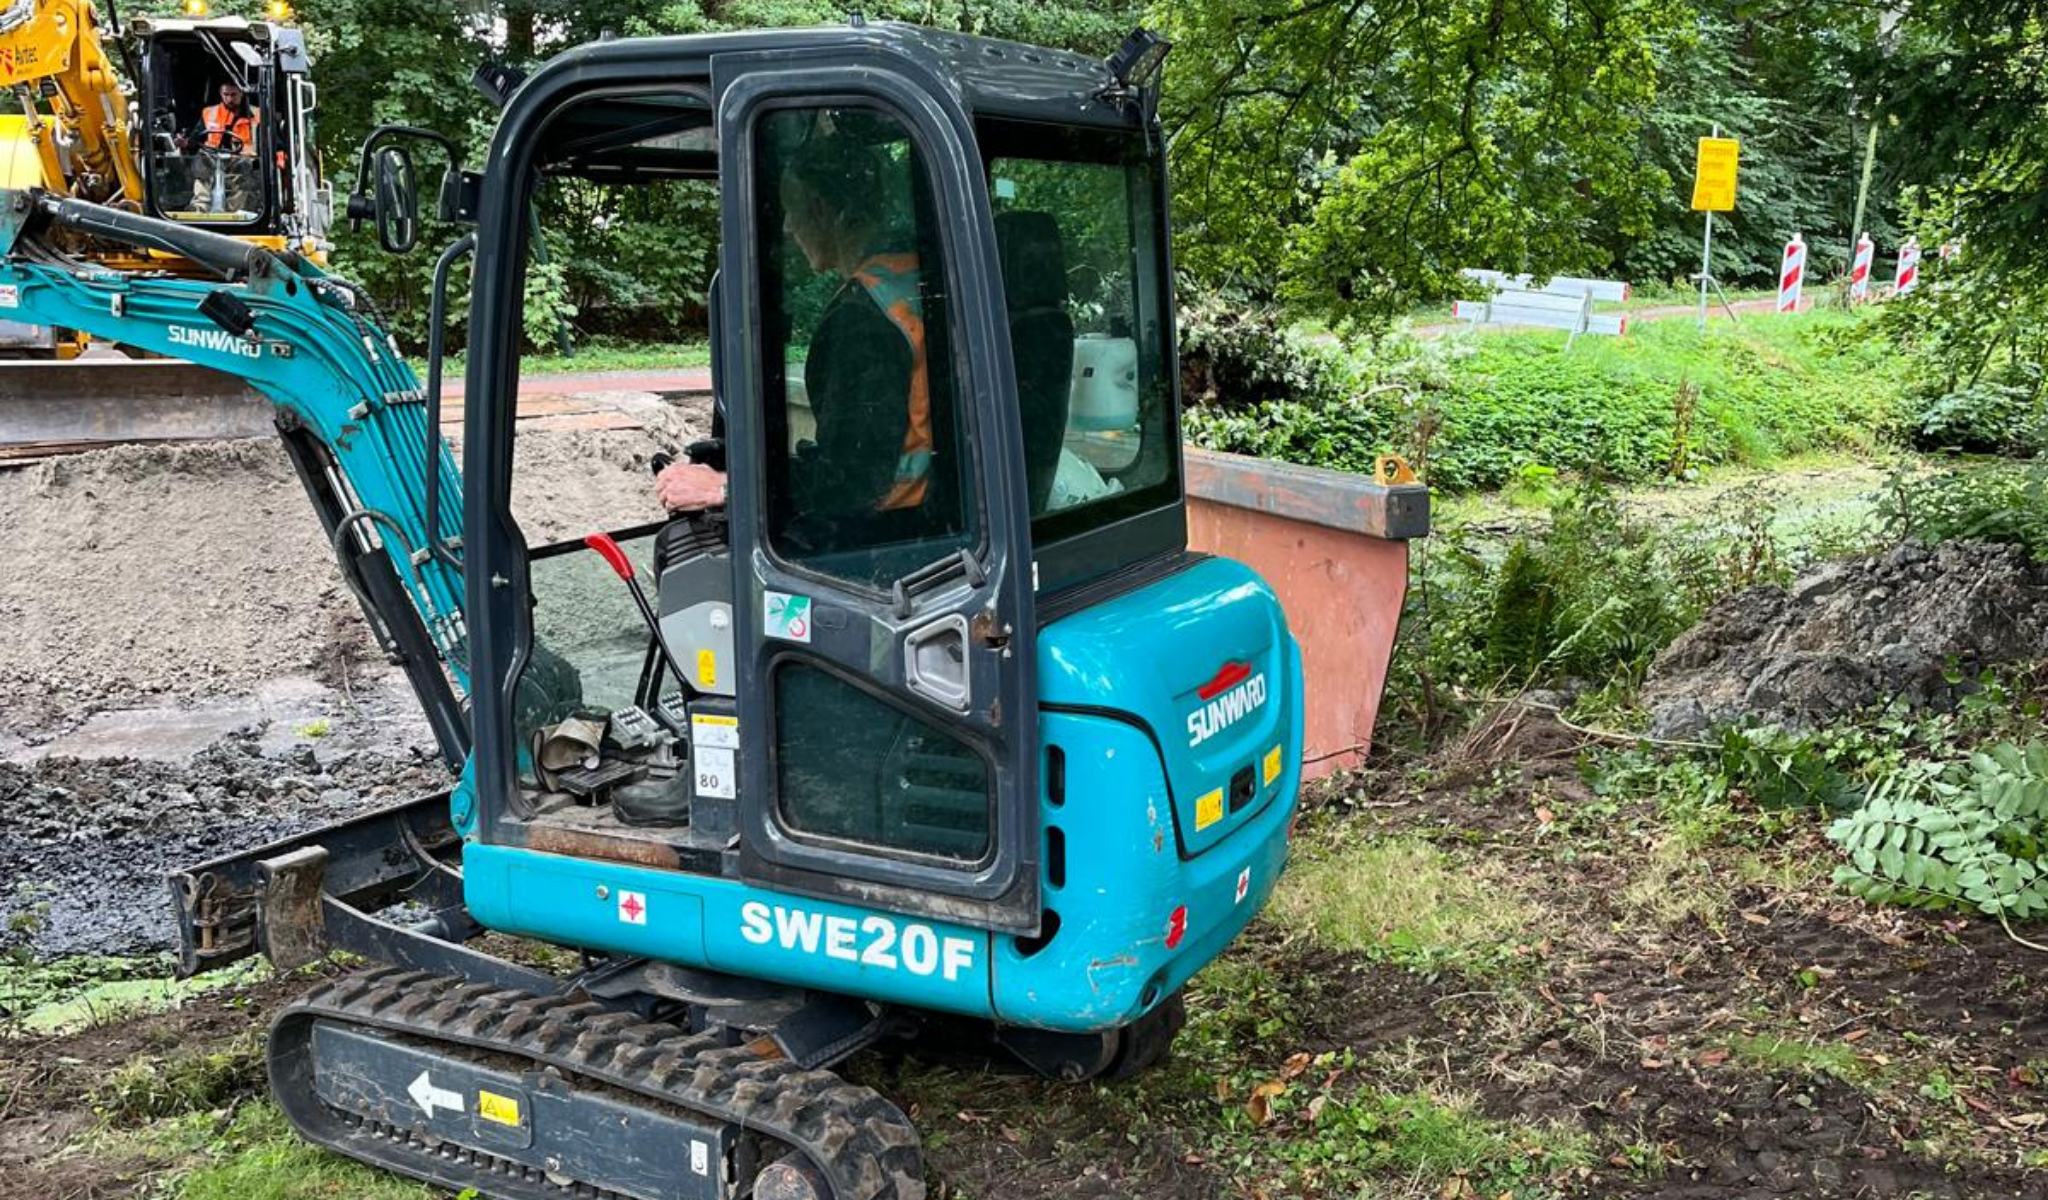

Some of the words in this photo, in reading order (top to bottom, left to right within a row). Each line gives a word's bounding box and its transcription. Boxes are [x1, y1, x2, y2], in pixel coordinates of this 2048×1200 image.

[168, 324, 261, 358] SUNWARD
[1187, 672, 1266, 748] SUNWARD
[700, 773, 719, 788] 80
[740, 901, 975, 981] SWE20F
